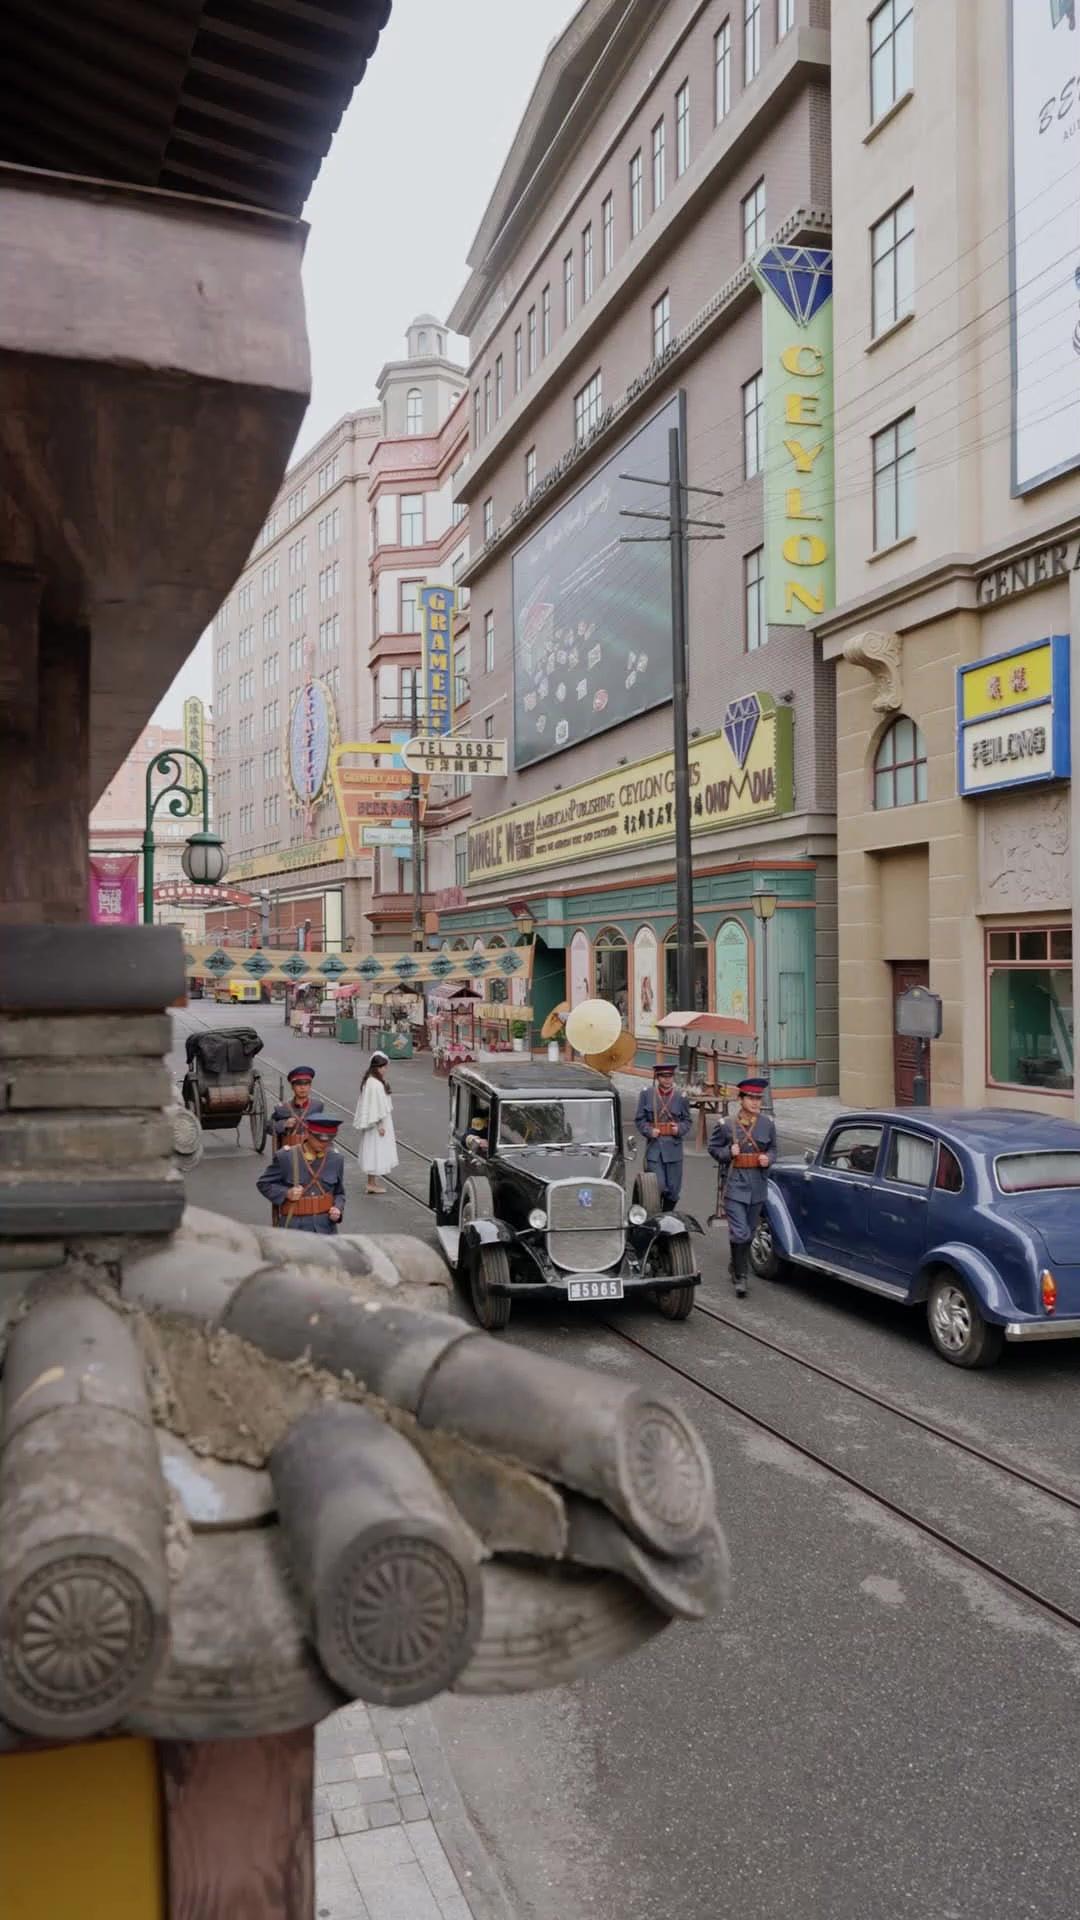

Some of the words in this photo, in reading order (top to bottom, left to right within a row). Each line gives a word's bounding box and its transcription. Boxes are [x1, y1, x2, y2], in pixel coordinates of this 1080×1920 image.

[780, 345, 828, 614] CEYLON
[419, 742, 445, 755] TEL
[455, 743, 494, 758] 3698
[619, 772, 663, 807] CEYLON
